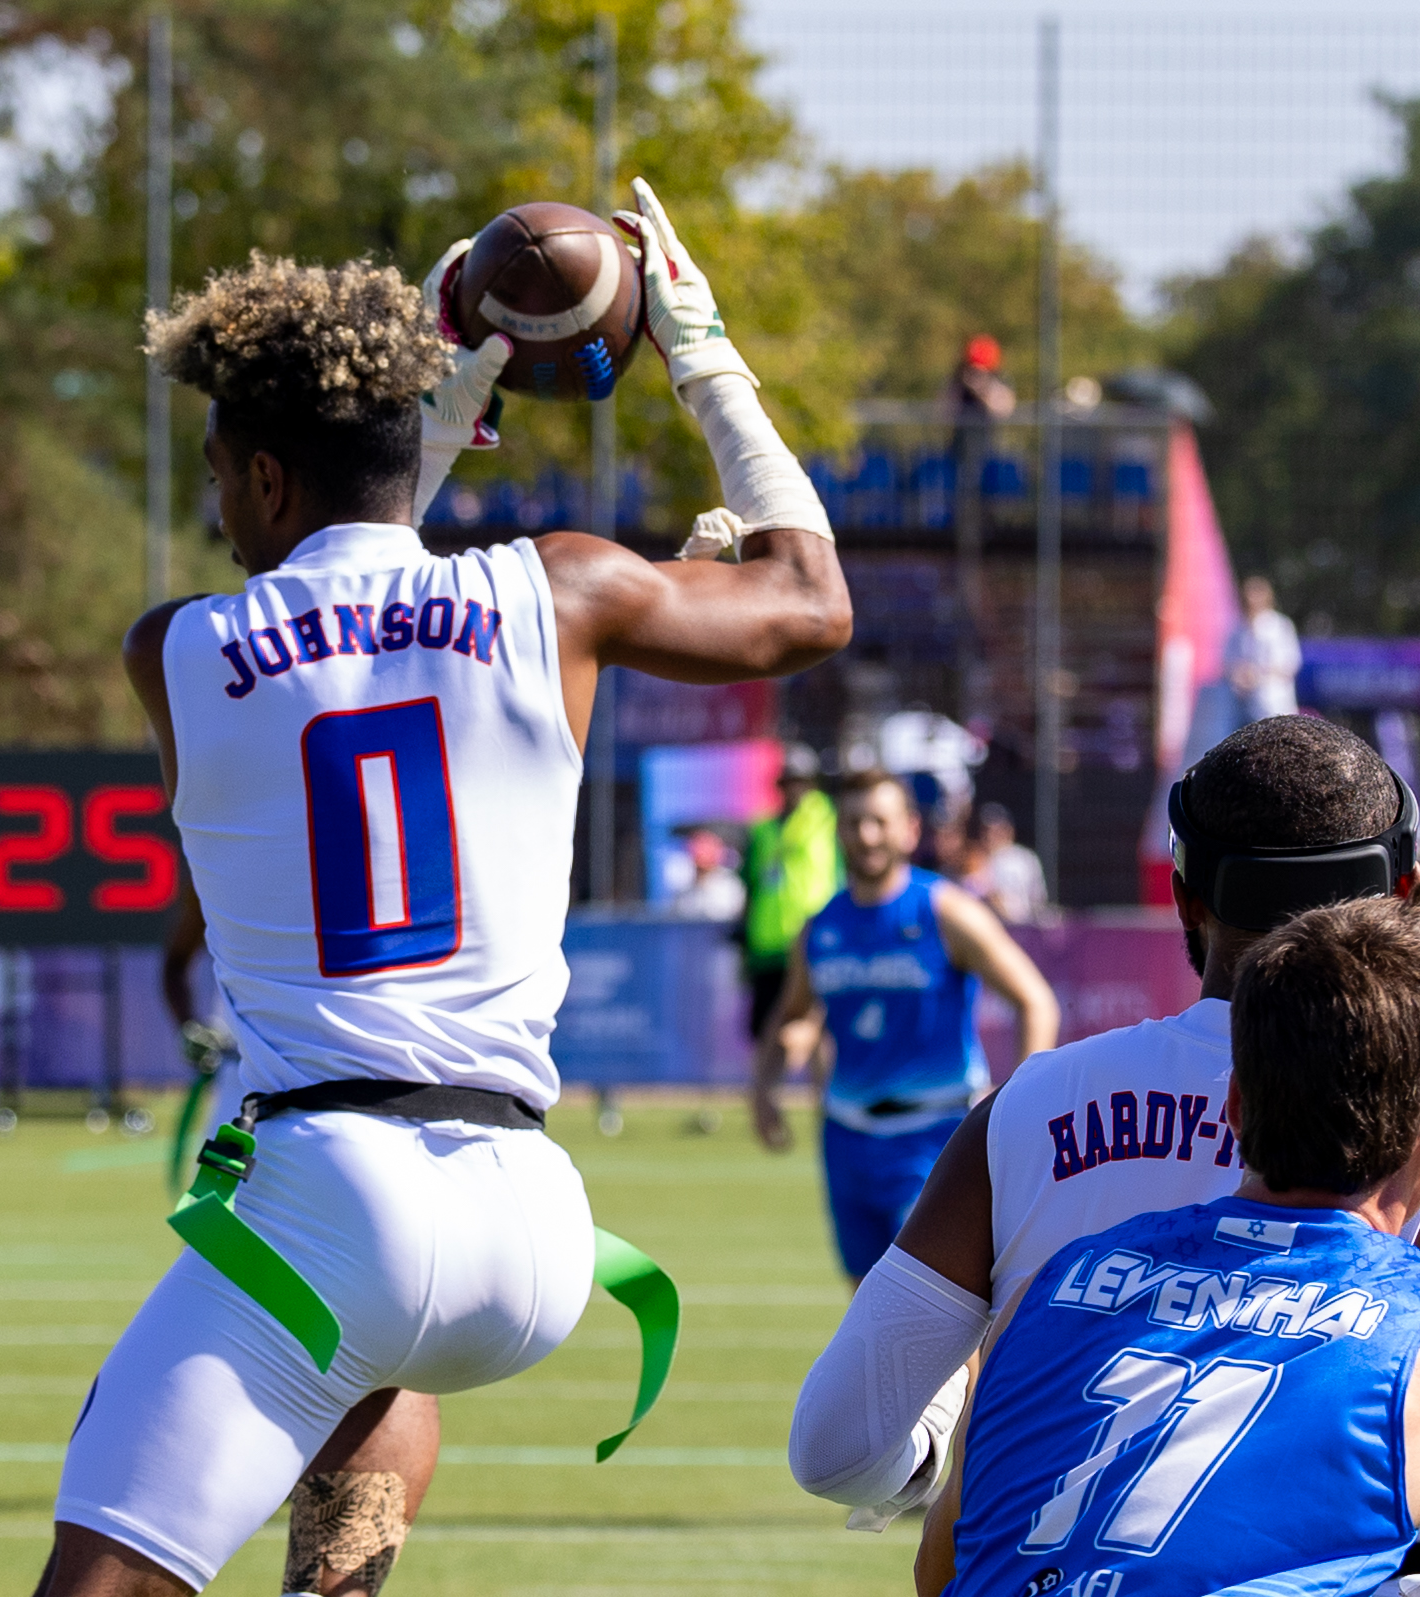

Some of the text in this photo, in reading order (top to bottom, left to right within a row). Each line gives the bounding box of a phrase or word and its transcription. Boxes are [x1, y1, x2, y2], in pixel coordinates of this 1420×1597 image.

[220, 596, 504, 700] JOHNSON
[301, 695, 463, 978] 0
[1017, 1347, 1283, 1557] 11
